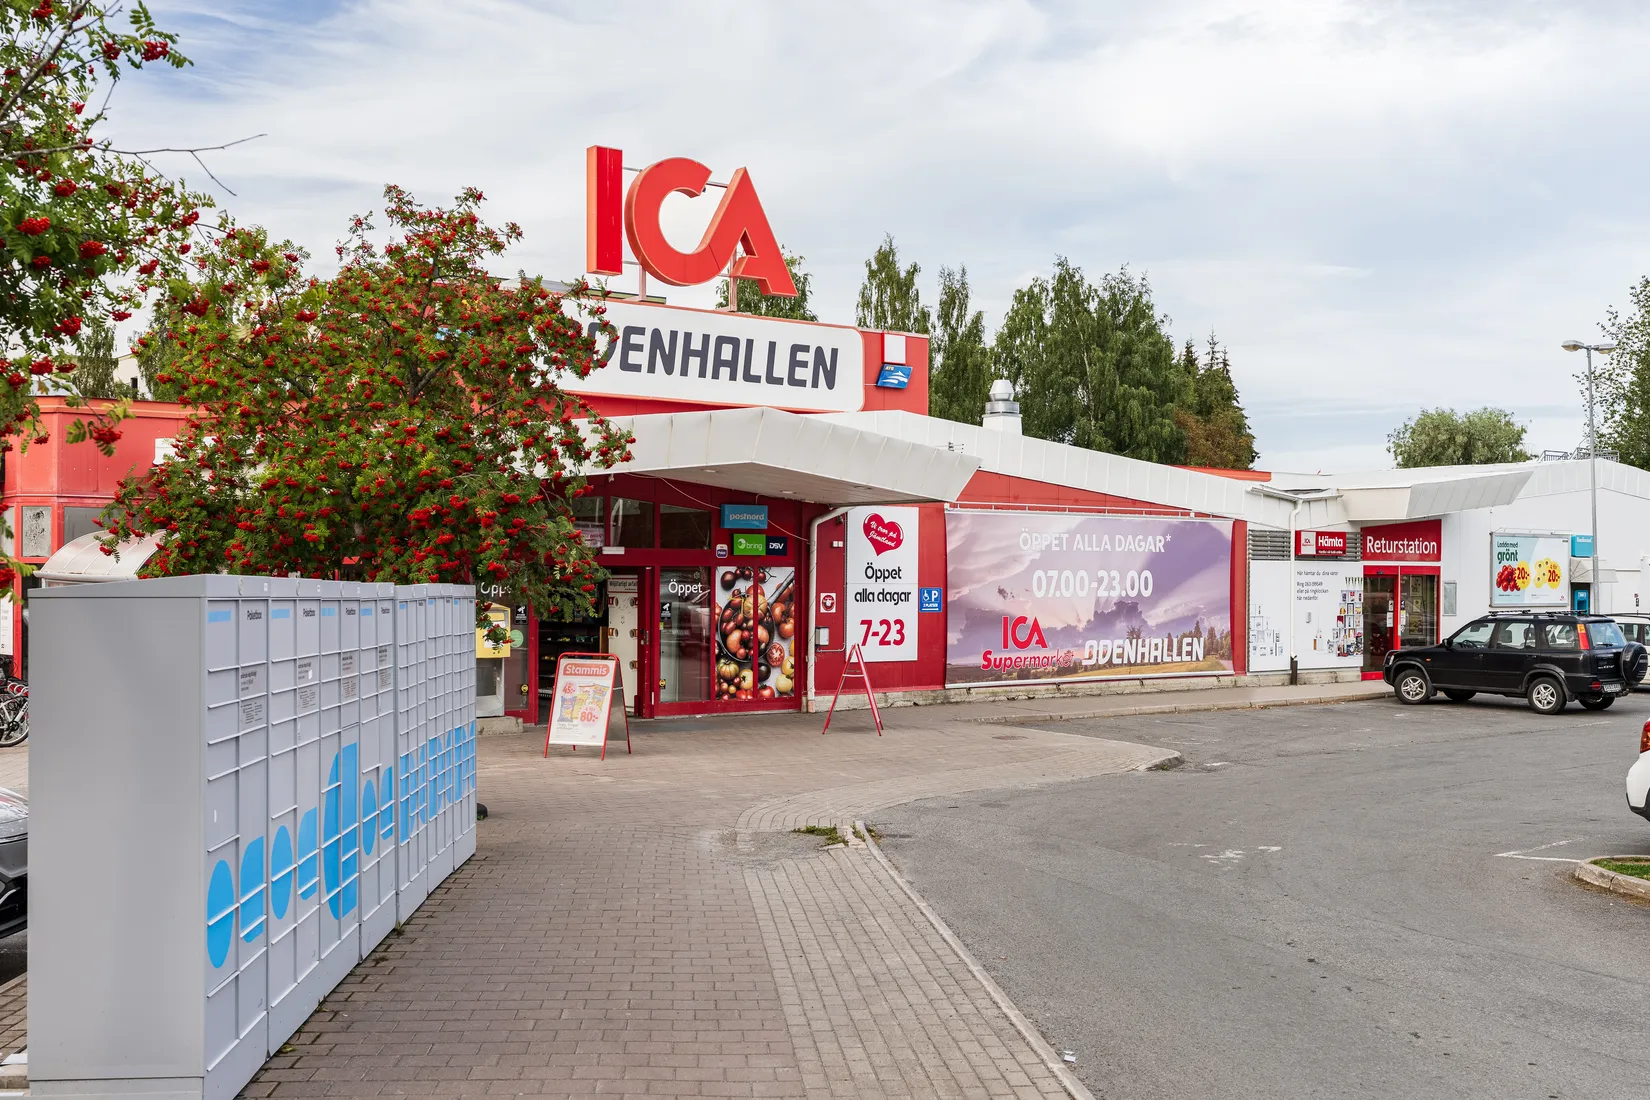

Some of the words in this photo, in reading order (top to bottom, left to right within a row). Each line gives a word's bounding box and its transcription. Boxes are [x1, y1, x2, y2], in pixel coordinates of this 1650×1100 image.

[587, 145, 798, 297] ICA
[543, 320, 838, 390] DENHALLEN
[729, 513, 765, 521] postnord
[877, 526, 888, 535] tror
[746, 542, 763, 551] bring
[769, 542, 784, 550] DSV
[868, 531, 897, 547] Jämtland
[1020, 528, 1069, 551] ÖPPET
[1073, 533, 1112, 552] ALLA
[1318, 535, 1343, 547] Hämta
[1366, 535, 1437, 555] Returstation
[1497, 549, 1519, 564] grönt
[865, 562, 902, 582] Öppet
[1517, 567, 1530, 580] 20:-
[1548, 570, 1560, 582] 20:-
[669, 579, 702, 596] Öppet
[1032, 569, 1153, 598] 07.00-23.00
[854, 588, 875, 603] alla
[877, 588, 911, 606] dagar
[931, 590, 939, 602] P
[859, 618, 905, 647] 7-23
[1001, 615, 1049, 651] ICA
[1081, 637, 1205, 666] ODENHALLEN
[981, 648, 1075, 673] Supermarket
[566, 665, 607, 676] Stammis
[580, 712, 599, 722] 80:-
